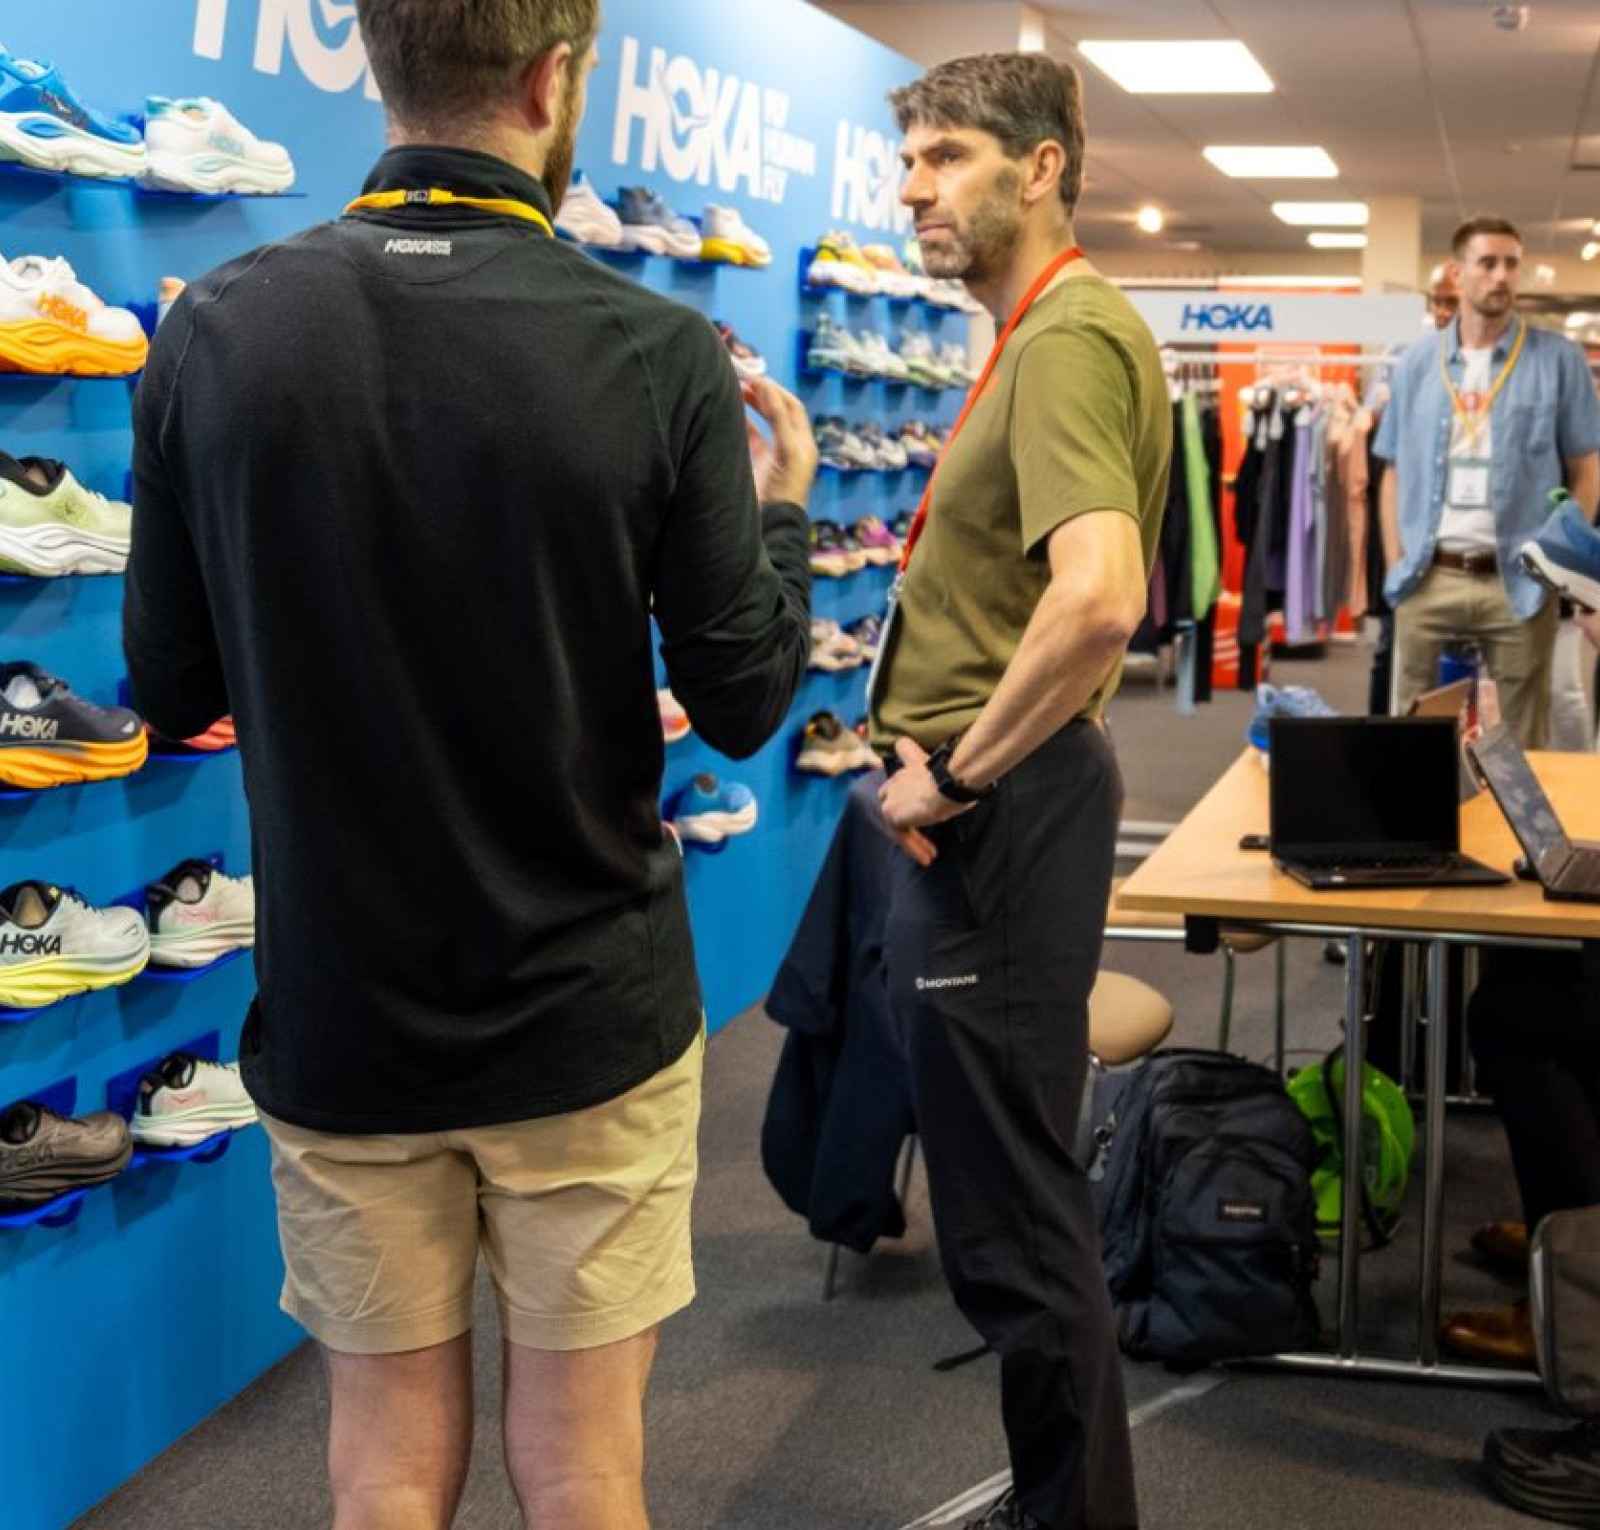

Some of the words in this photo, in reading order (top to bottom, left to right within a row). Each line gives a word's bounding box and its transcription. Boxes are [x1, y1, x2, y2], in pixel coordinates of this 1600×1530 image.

[612, 35, 763, 199] HOKA
[831, 118, 915, 234] HOK
[1180, 303, 1274, 332] HOKA
[0, 712, 59, 740] HOKA
[0, 932, 62, 955] HOKA
